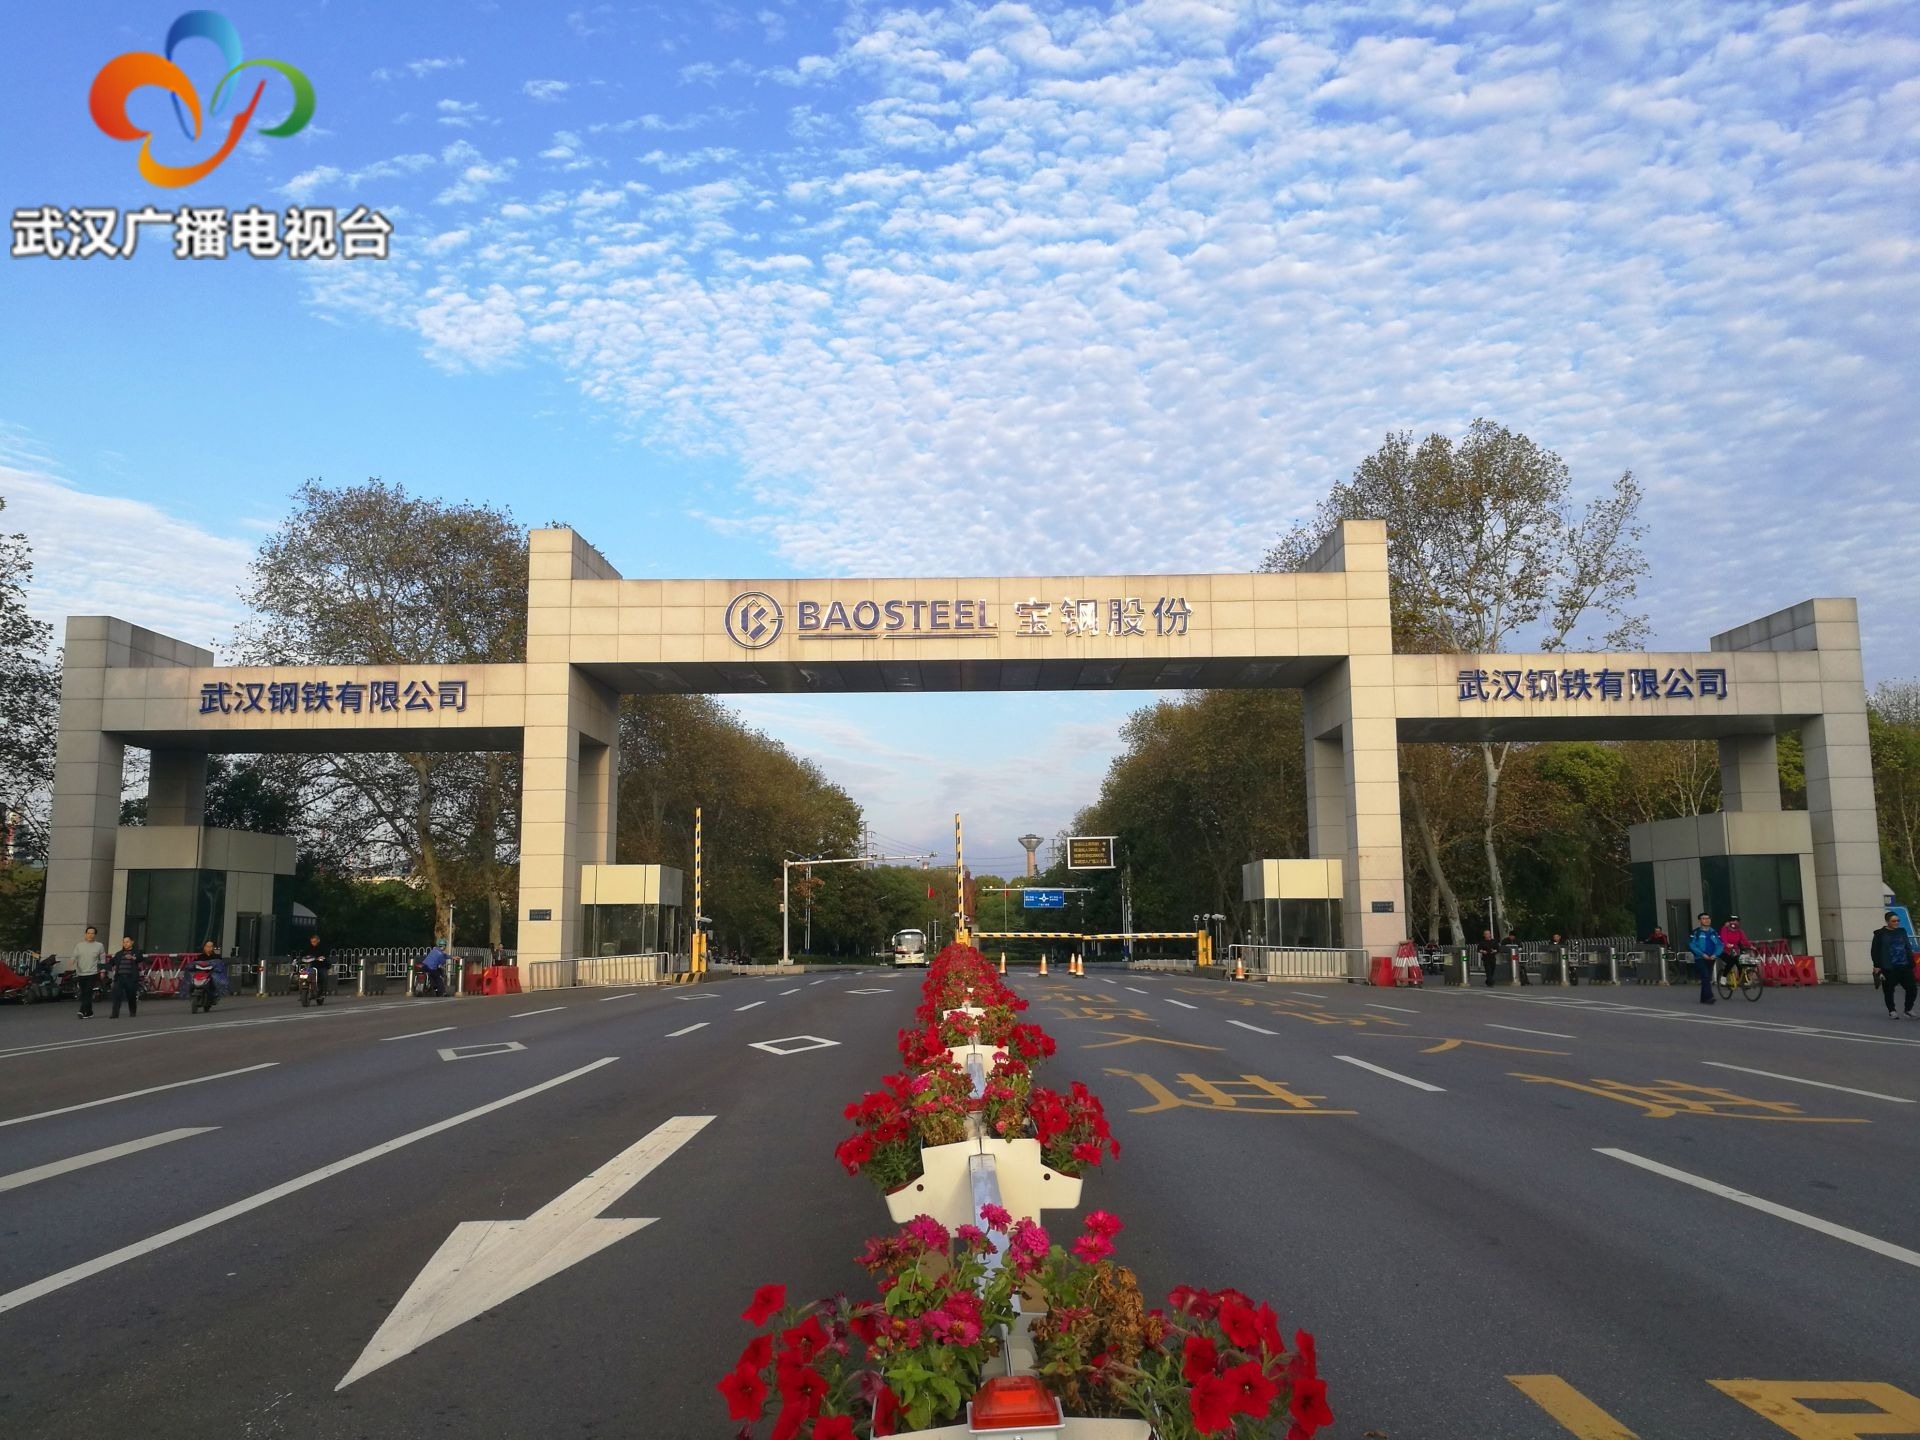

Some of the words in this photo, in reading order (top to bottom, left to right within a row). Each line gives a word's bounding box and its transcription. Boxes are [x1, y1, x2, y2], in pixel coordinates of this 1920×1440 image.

[797, 599, 998, 631] BAOSTEEL
[1015, 596, 1193, 637] 宝钢股份
[199, 679, 468, 715] 武汉钢铁有限公司
[1457, 667, 1728, 702] 武汉钢铁有限公司
